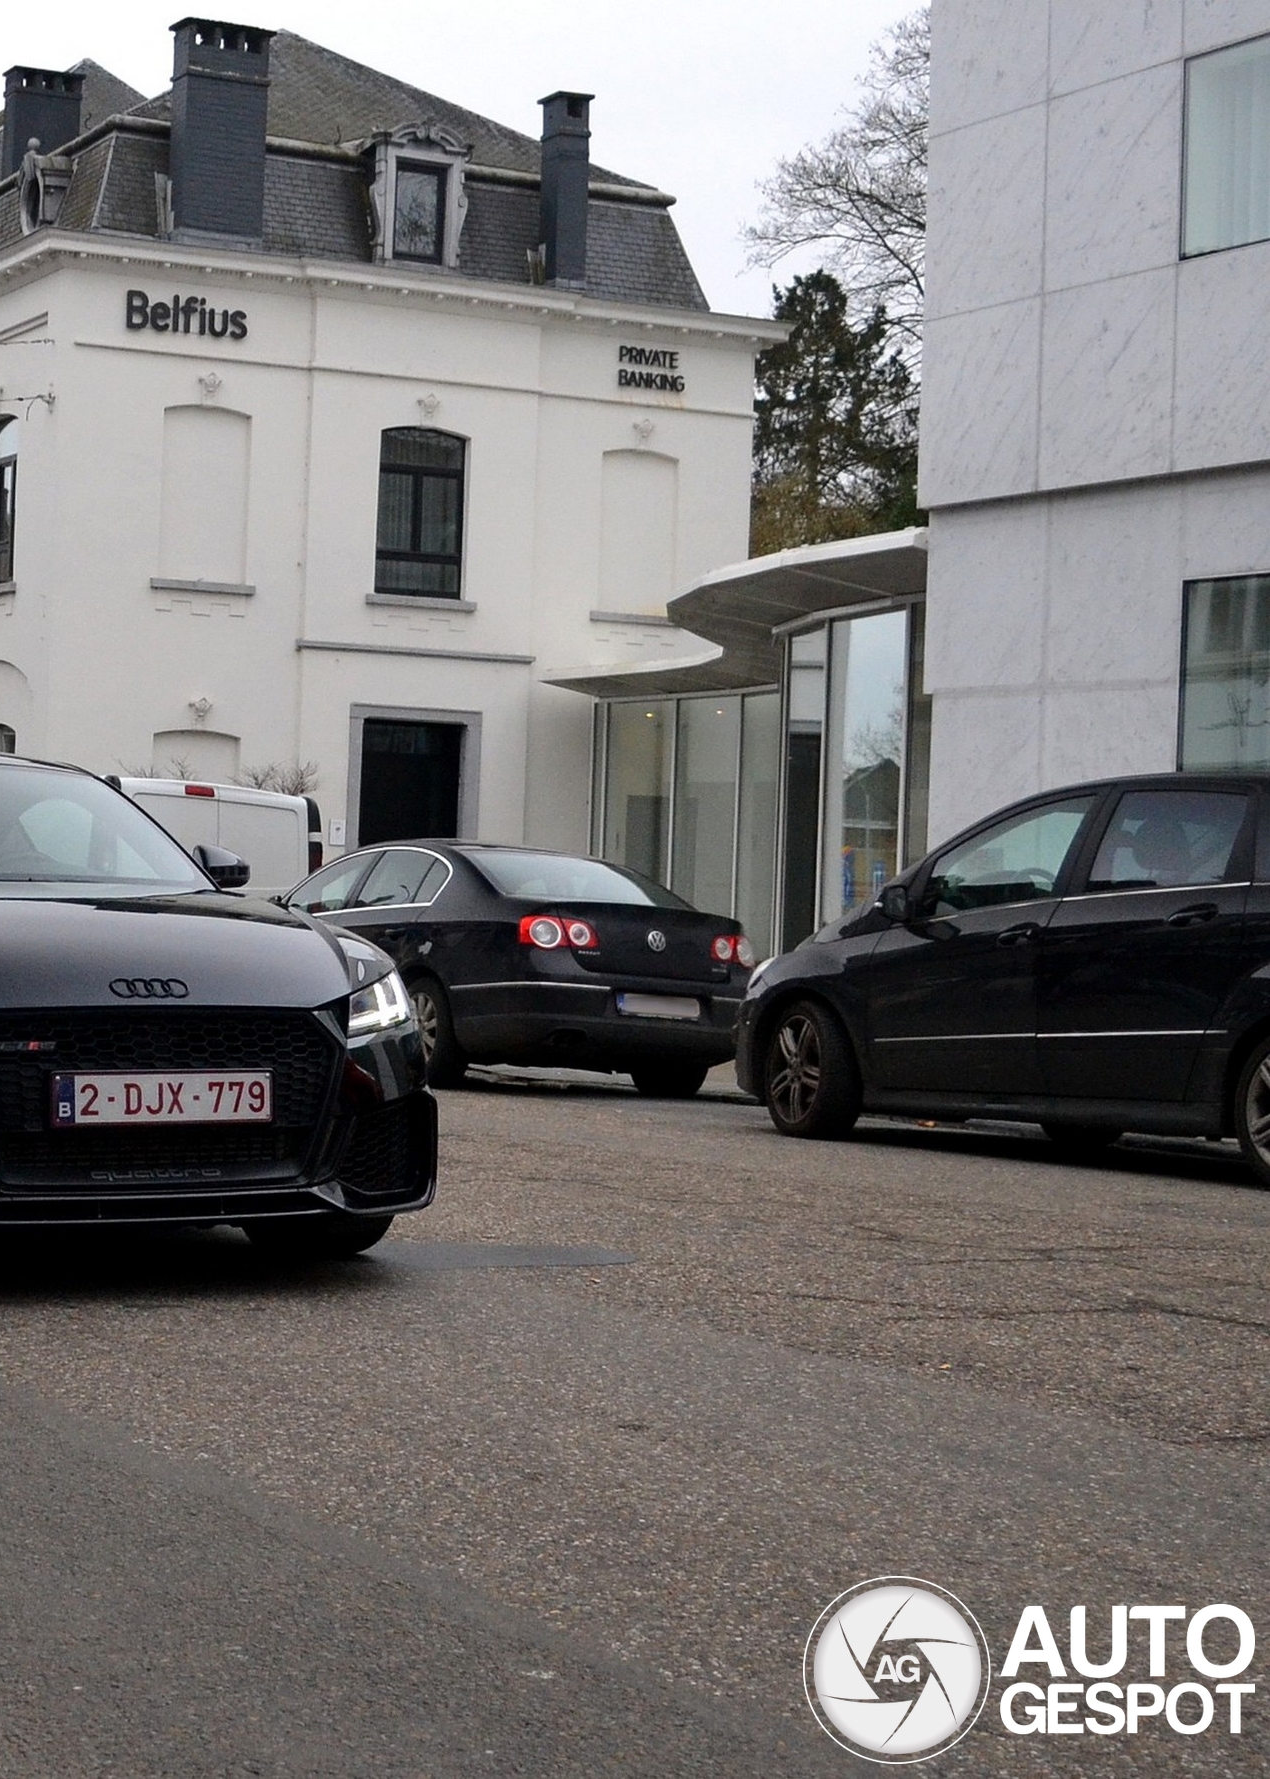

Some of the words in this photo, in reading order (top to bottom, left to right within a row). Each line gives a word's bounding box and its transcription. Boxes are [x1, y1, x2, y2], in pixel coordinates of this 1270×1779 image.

[126, 289, 248, 340] Belfius
[618, 345, 680, 370] PRIVATE
[618, 368, 686, 393] BANKING
[58, 1102, 72, 1118] B
[79, 1080, 266, 1117] 2-DJX-779
[90, 1167, 222, 1182] quattro
